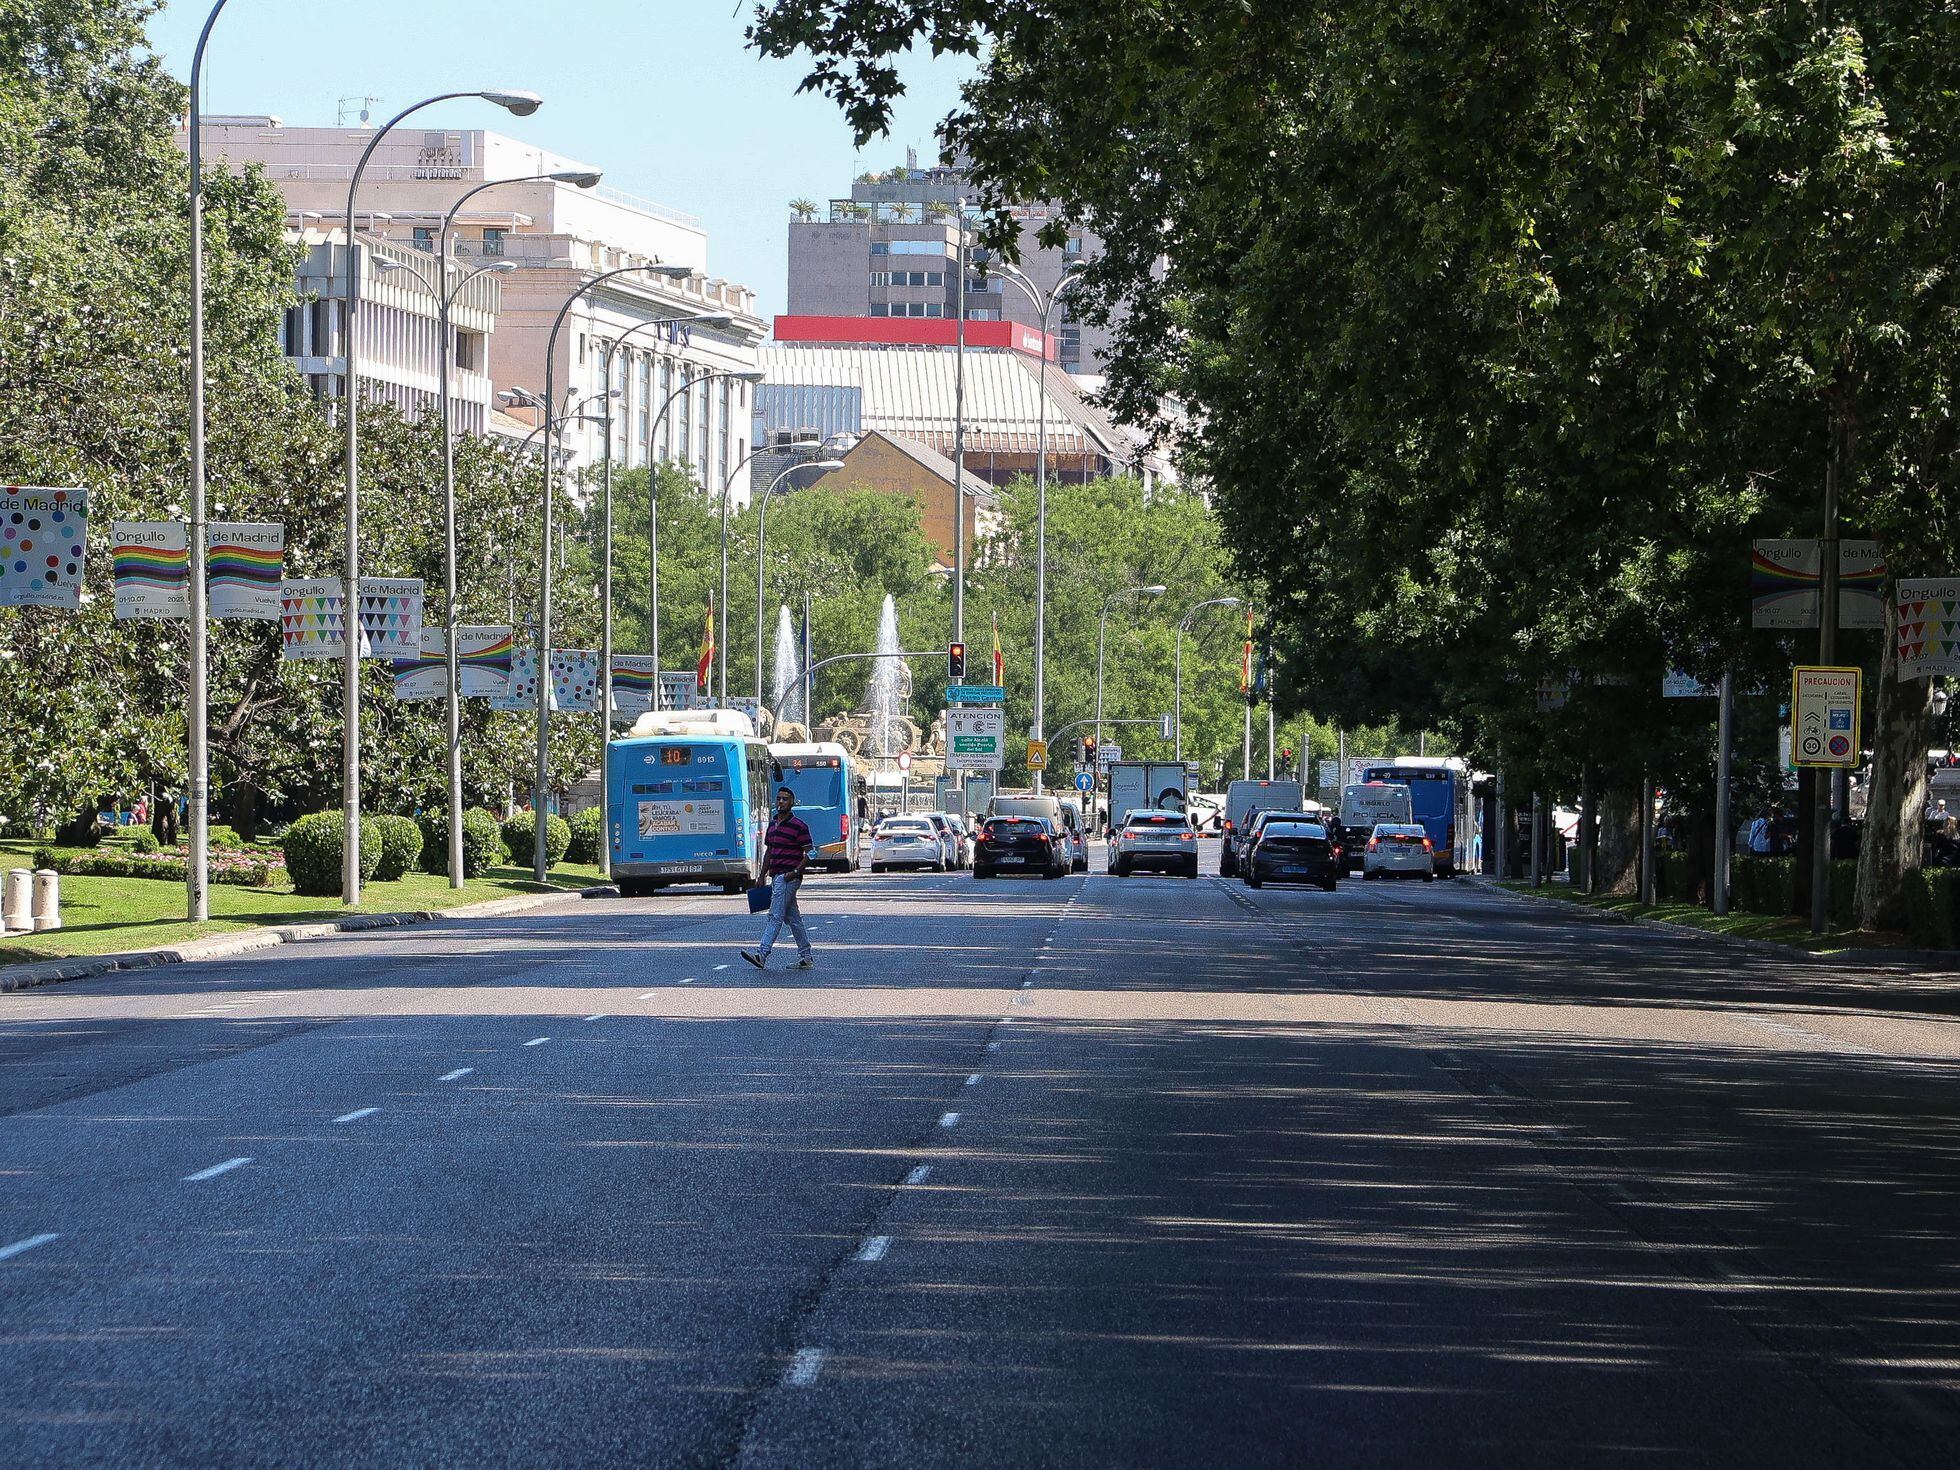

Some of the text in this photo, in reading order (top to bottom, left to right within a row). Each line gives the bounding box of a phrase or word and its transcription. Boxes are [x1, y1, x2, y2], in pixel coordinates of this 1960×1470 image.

[0, 498, 83, 512] de Madrid
[116, 531, 165, 544] Orgullo
[212, 532, 279, 543] de Madrid
[1757, 547, 1802, 560] Orgullo
[1843, 548, 1858, 558] de
[283, 586, 325, 597] Orgullo
[363, 585, 419, 595] de Madrid
[1901, 587, 1956, 600] Orgullo
[254, 596, 276, 604] Vuelve
[461, 632, 510, 640] de Madrid
[564, 655, 595, 663] Madrid
[625, 660, 653, 668] Madrid
[1926, 665, 1956, 673] MADRID
[1804, 677, 1851, 686] PRECAUCIÓN
[1806, 742, 1817, 750] 30
[667, 750, 680, 763] 10
[792, 759, 802, 767] 34
